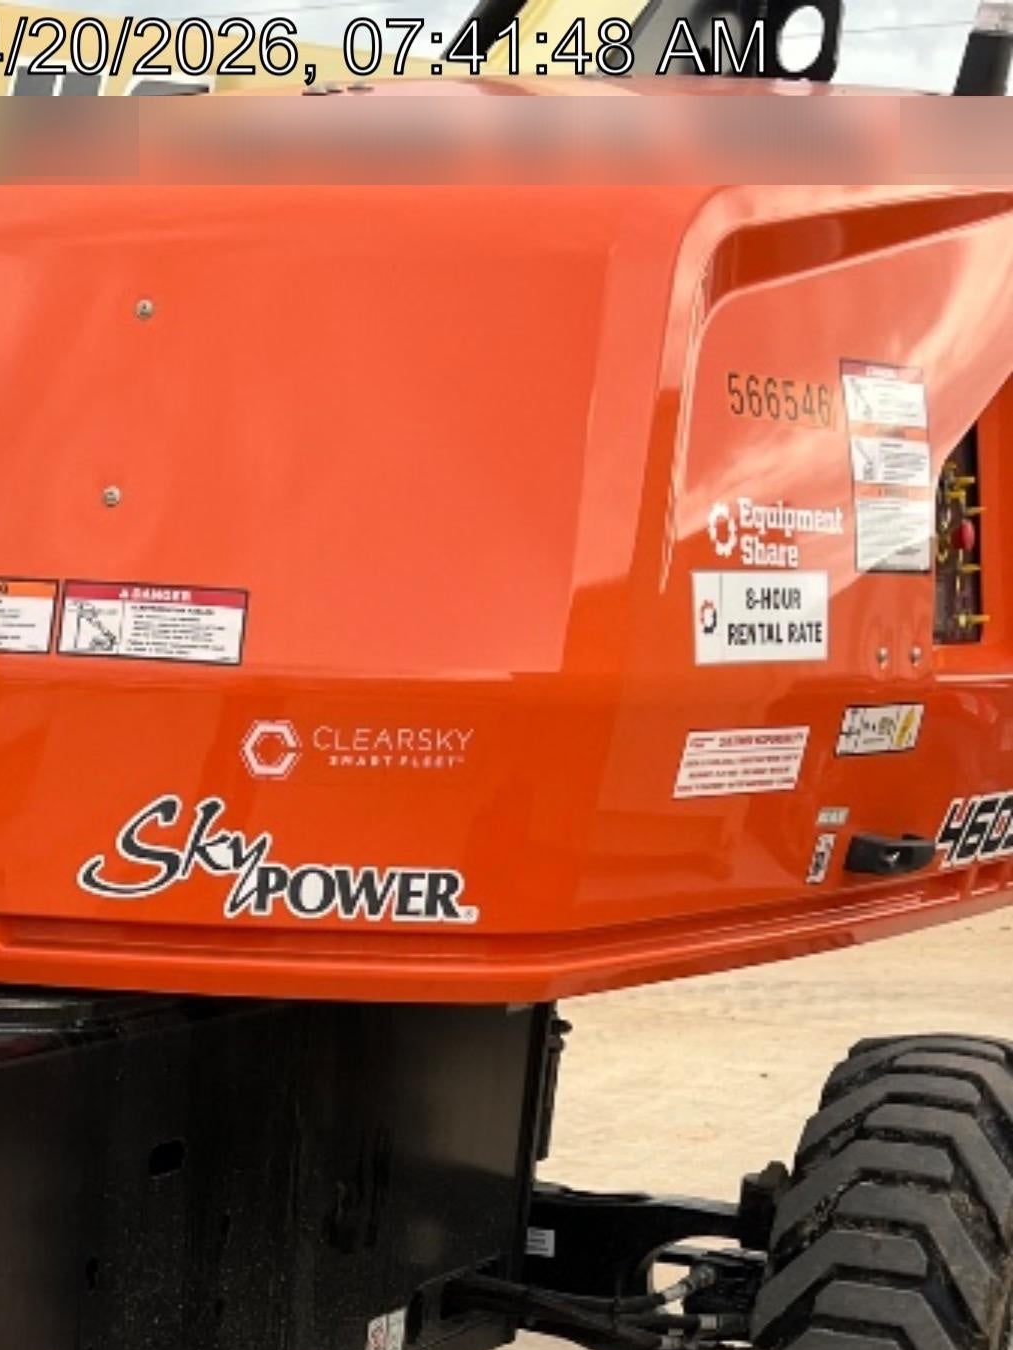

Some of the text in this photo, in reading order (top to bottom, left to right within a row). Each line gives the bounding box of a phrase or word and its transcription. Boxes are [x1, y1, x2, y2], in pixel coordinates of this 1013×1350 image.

[728, 371, 832, 427] 566546
[737, 497, 844, 537] Equipment
[740, 535, 799, 568] Share
[745, 586, 802, 611] 8-HOUR
[727, 620, 823, 646] RENTAL RATE
[313, 725, 475, 751] CLEARSKY
[934, 789, 1013, 869] 460
